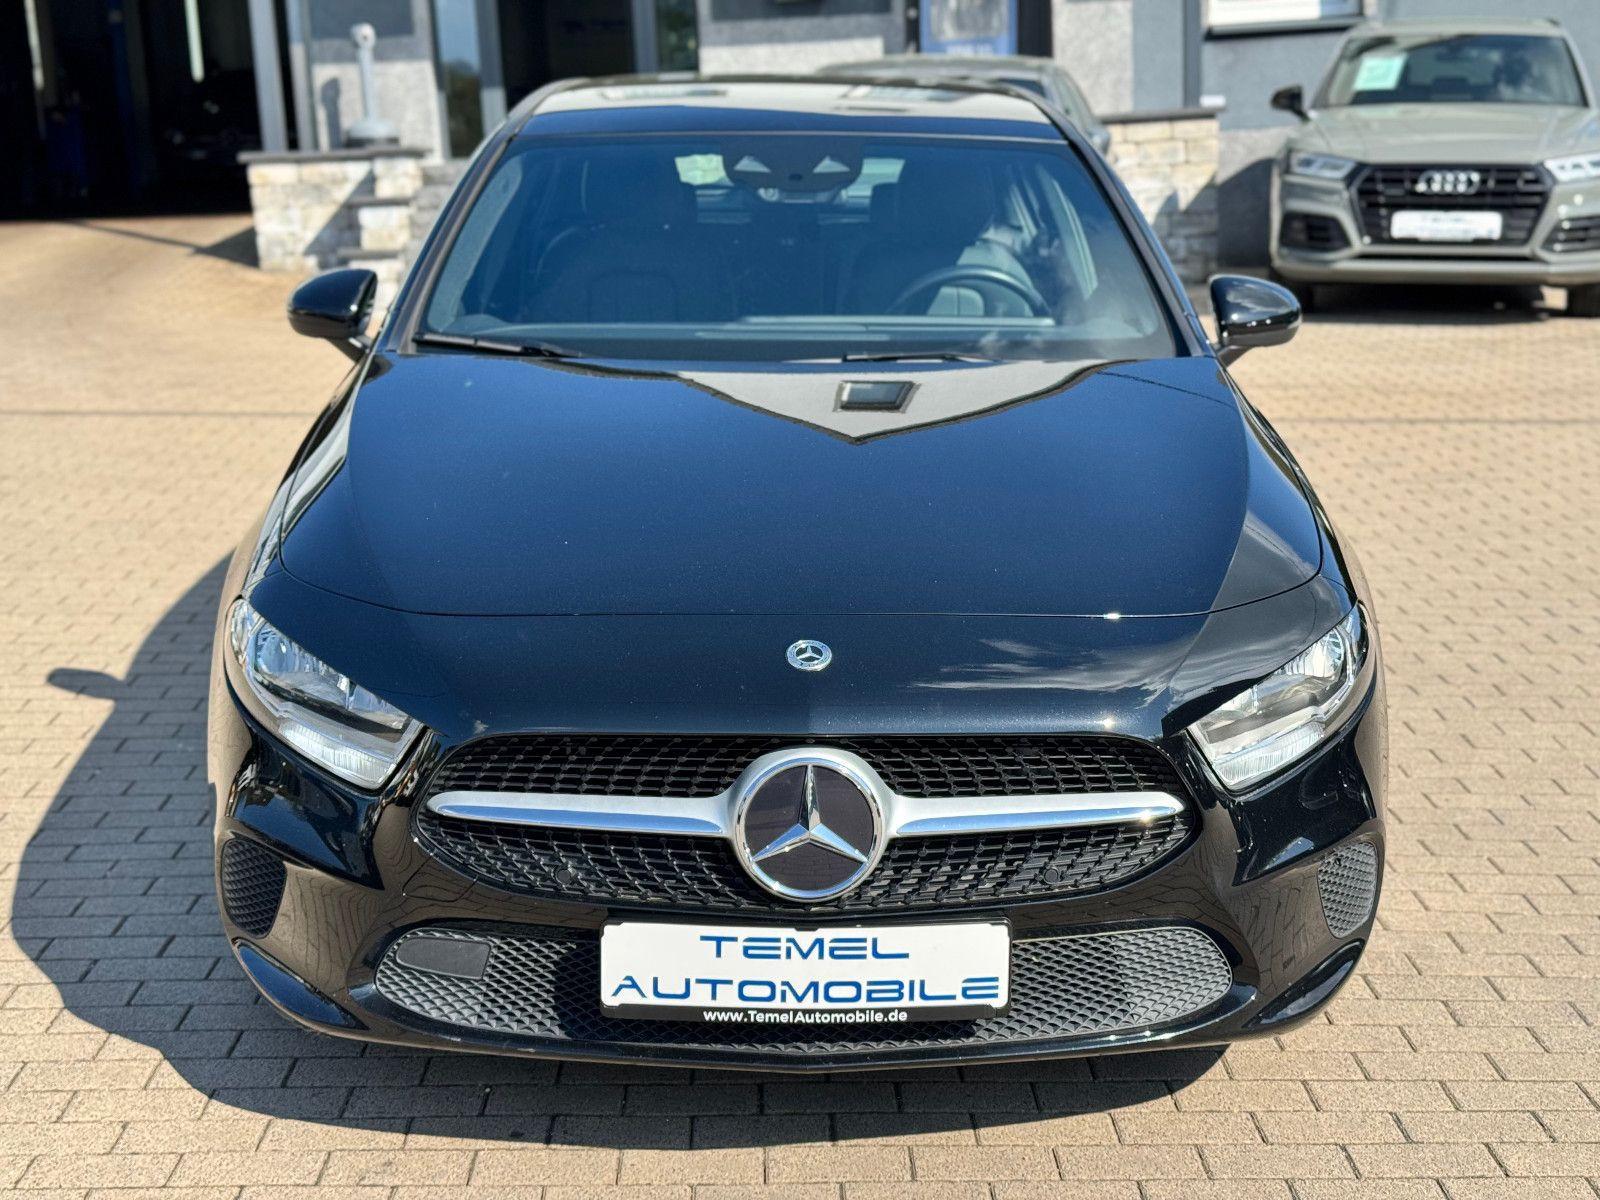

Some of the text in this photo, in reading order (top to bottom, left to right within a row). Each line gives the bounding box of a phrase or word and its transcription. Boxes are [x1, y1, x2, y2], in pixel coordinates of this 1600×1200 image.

[699, 935, 910, 960] TEMEL
[611, 975, 1000, 1004] AUTOMOBILE
[703, 1009, 908, 1024] www.TemelAutomobile.de
